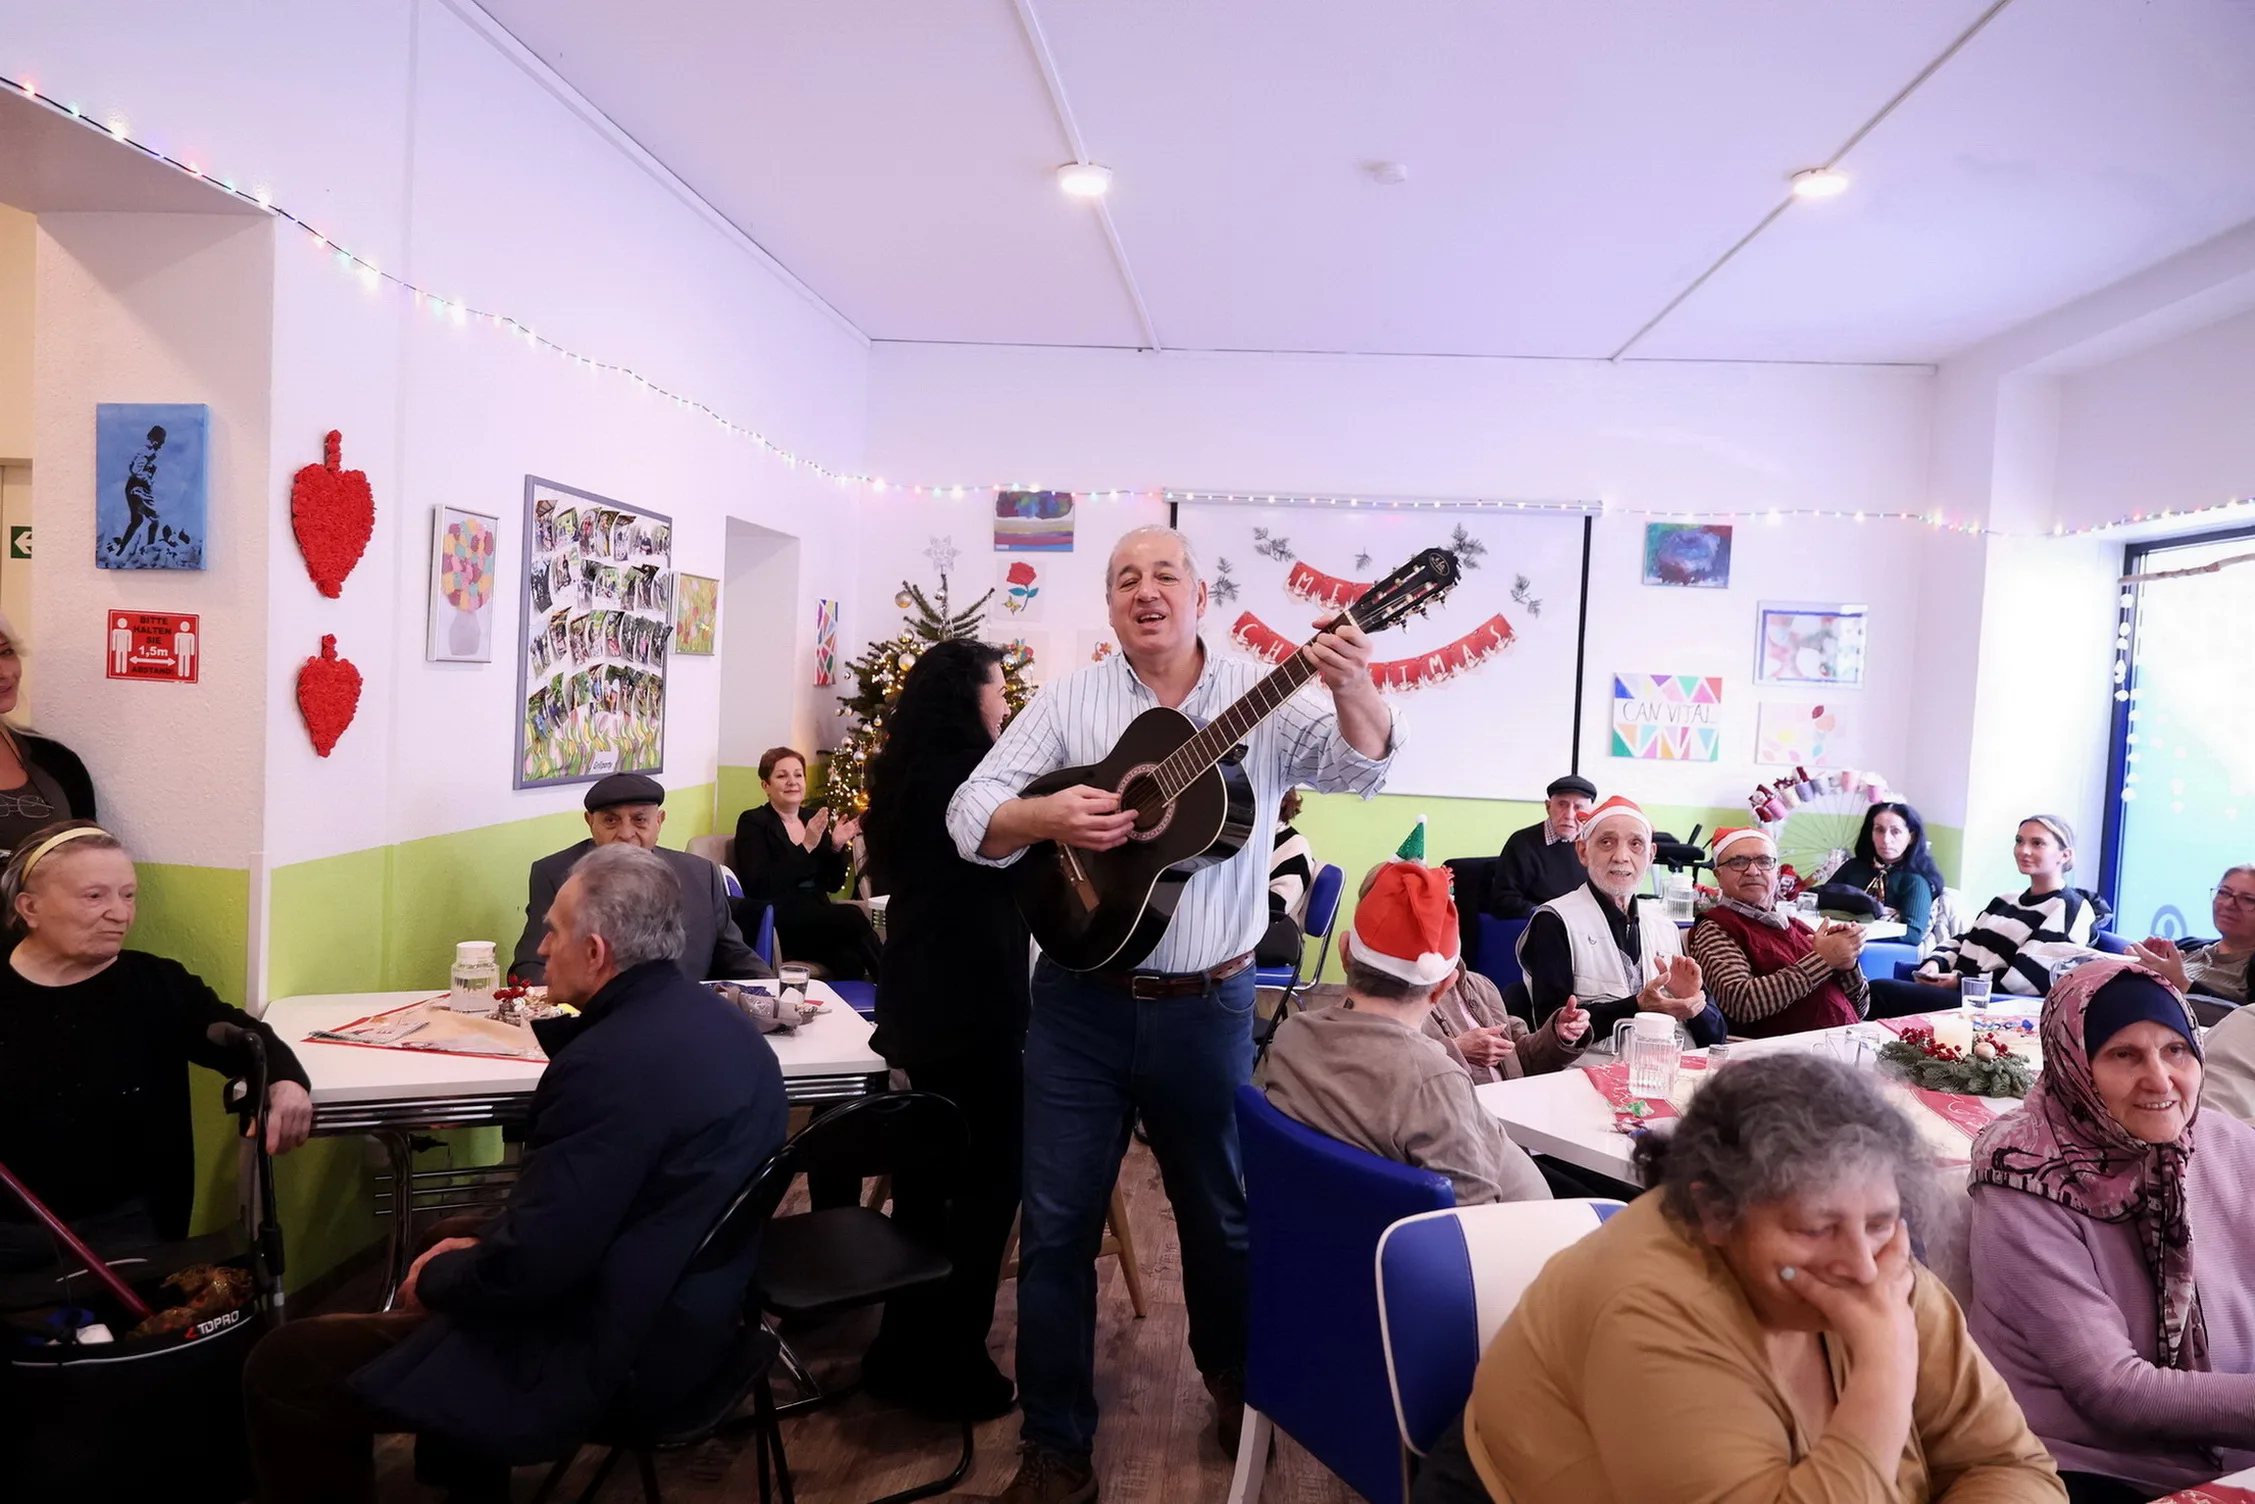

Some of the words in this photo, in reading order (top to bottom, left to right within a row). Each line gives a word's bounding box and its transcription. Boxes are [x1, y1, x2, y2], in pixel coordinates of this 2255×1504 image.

[140, 616, 168, 625] BITTE
[133, 626, 172, 635] HALTEN
[146, 636, 162, 645] SIE
[138, 645, 168, 658] 1,5m
[1238, 623, 1502, 686] CHTMAS
[1623, 701, 1661, 722] CAN
[1667, 702, 1717, 724] VITAL
[197, 1310, 239, 1334] TOPRO
